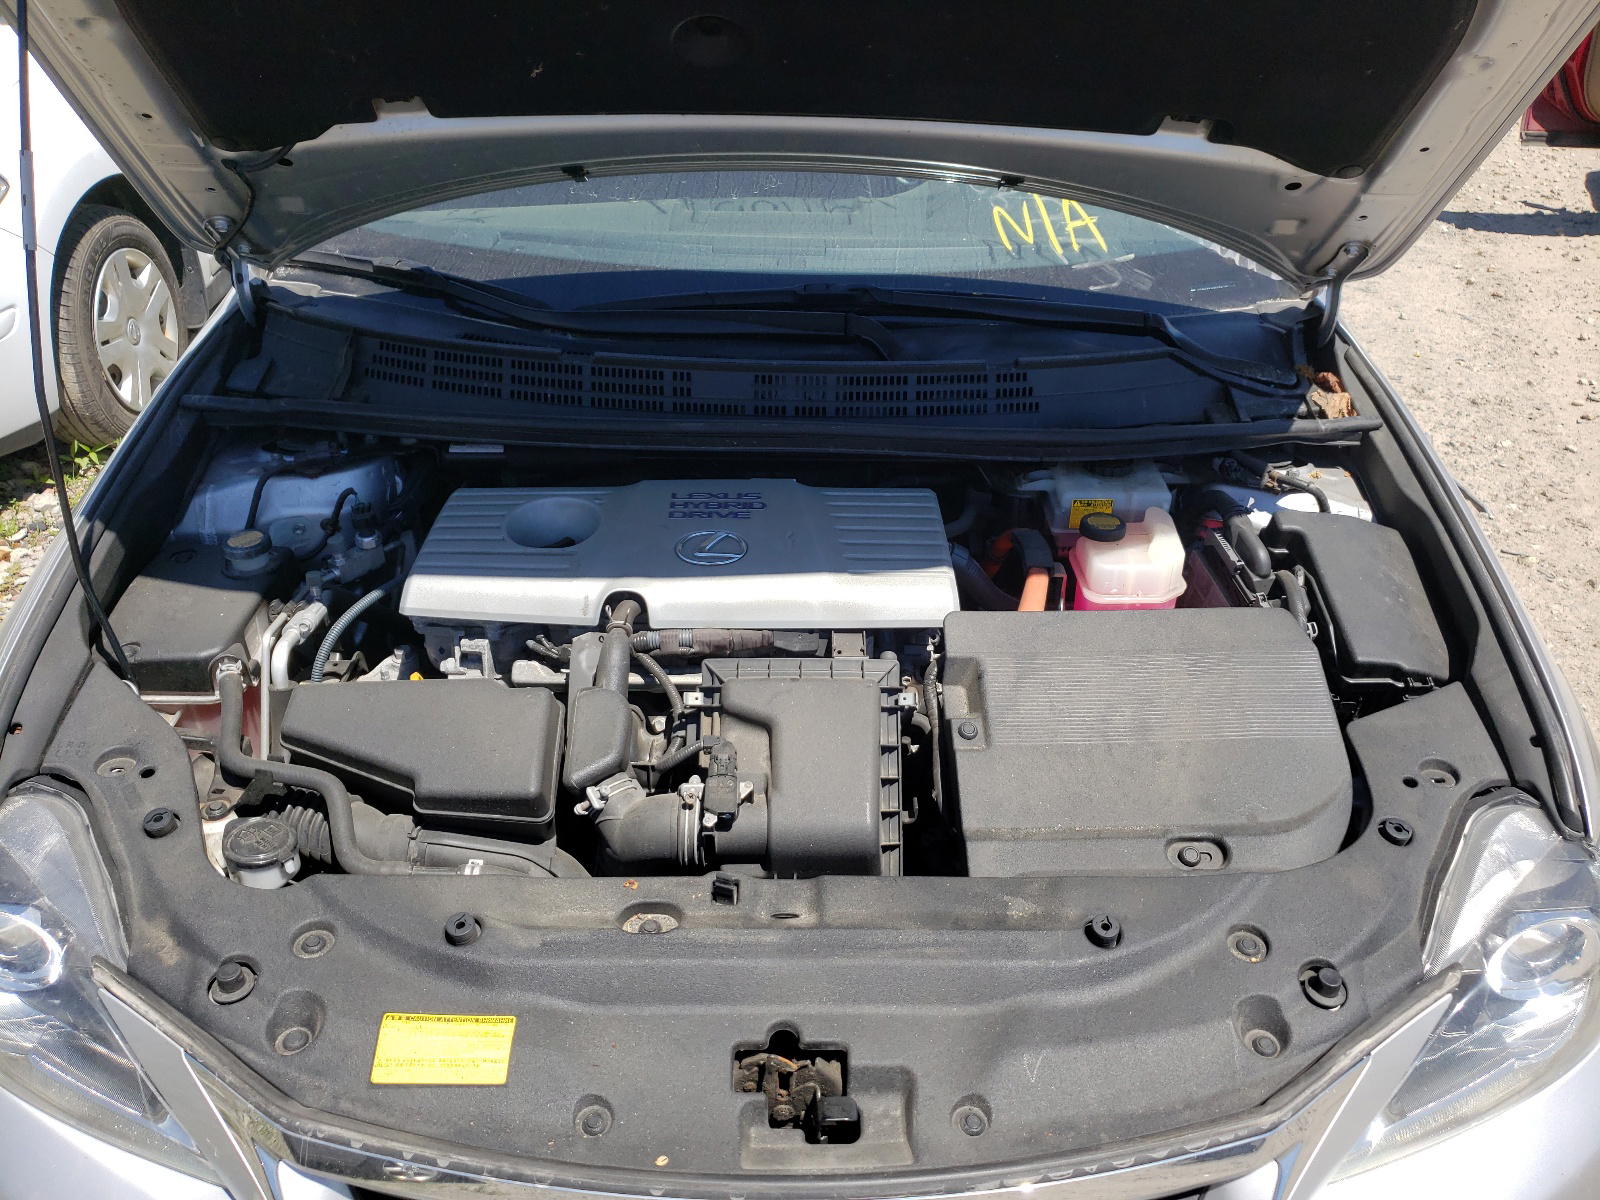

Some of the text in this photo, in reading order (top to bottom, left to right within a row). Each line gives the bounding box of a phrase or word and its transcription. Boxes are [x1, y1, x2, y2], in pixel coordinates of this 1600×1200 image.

[671, 492, 762, 500] LEXUS
[669, 501, 768, 510] HYBRID
[667, 510, 751, 519] DRIVE
